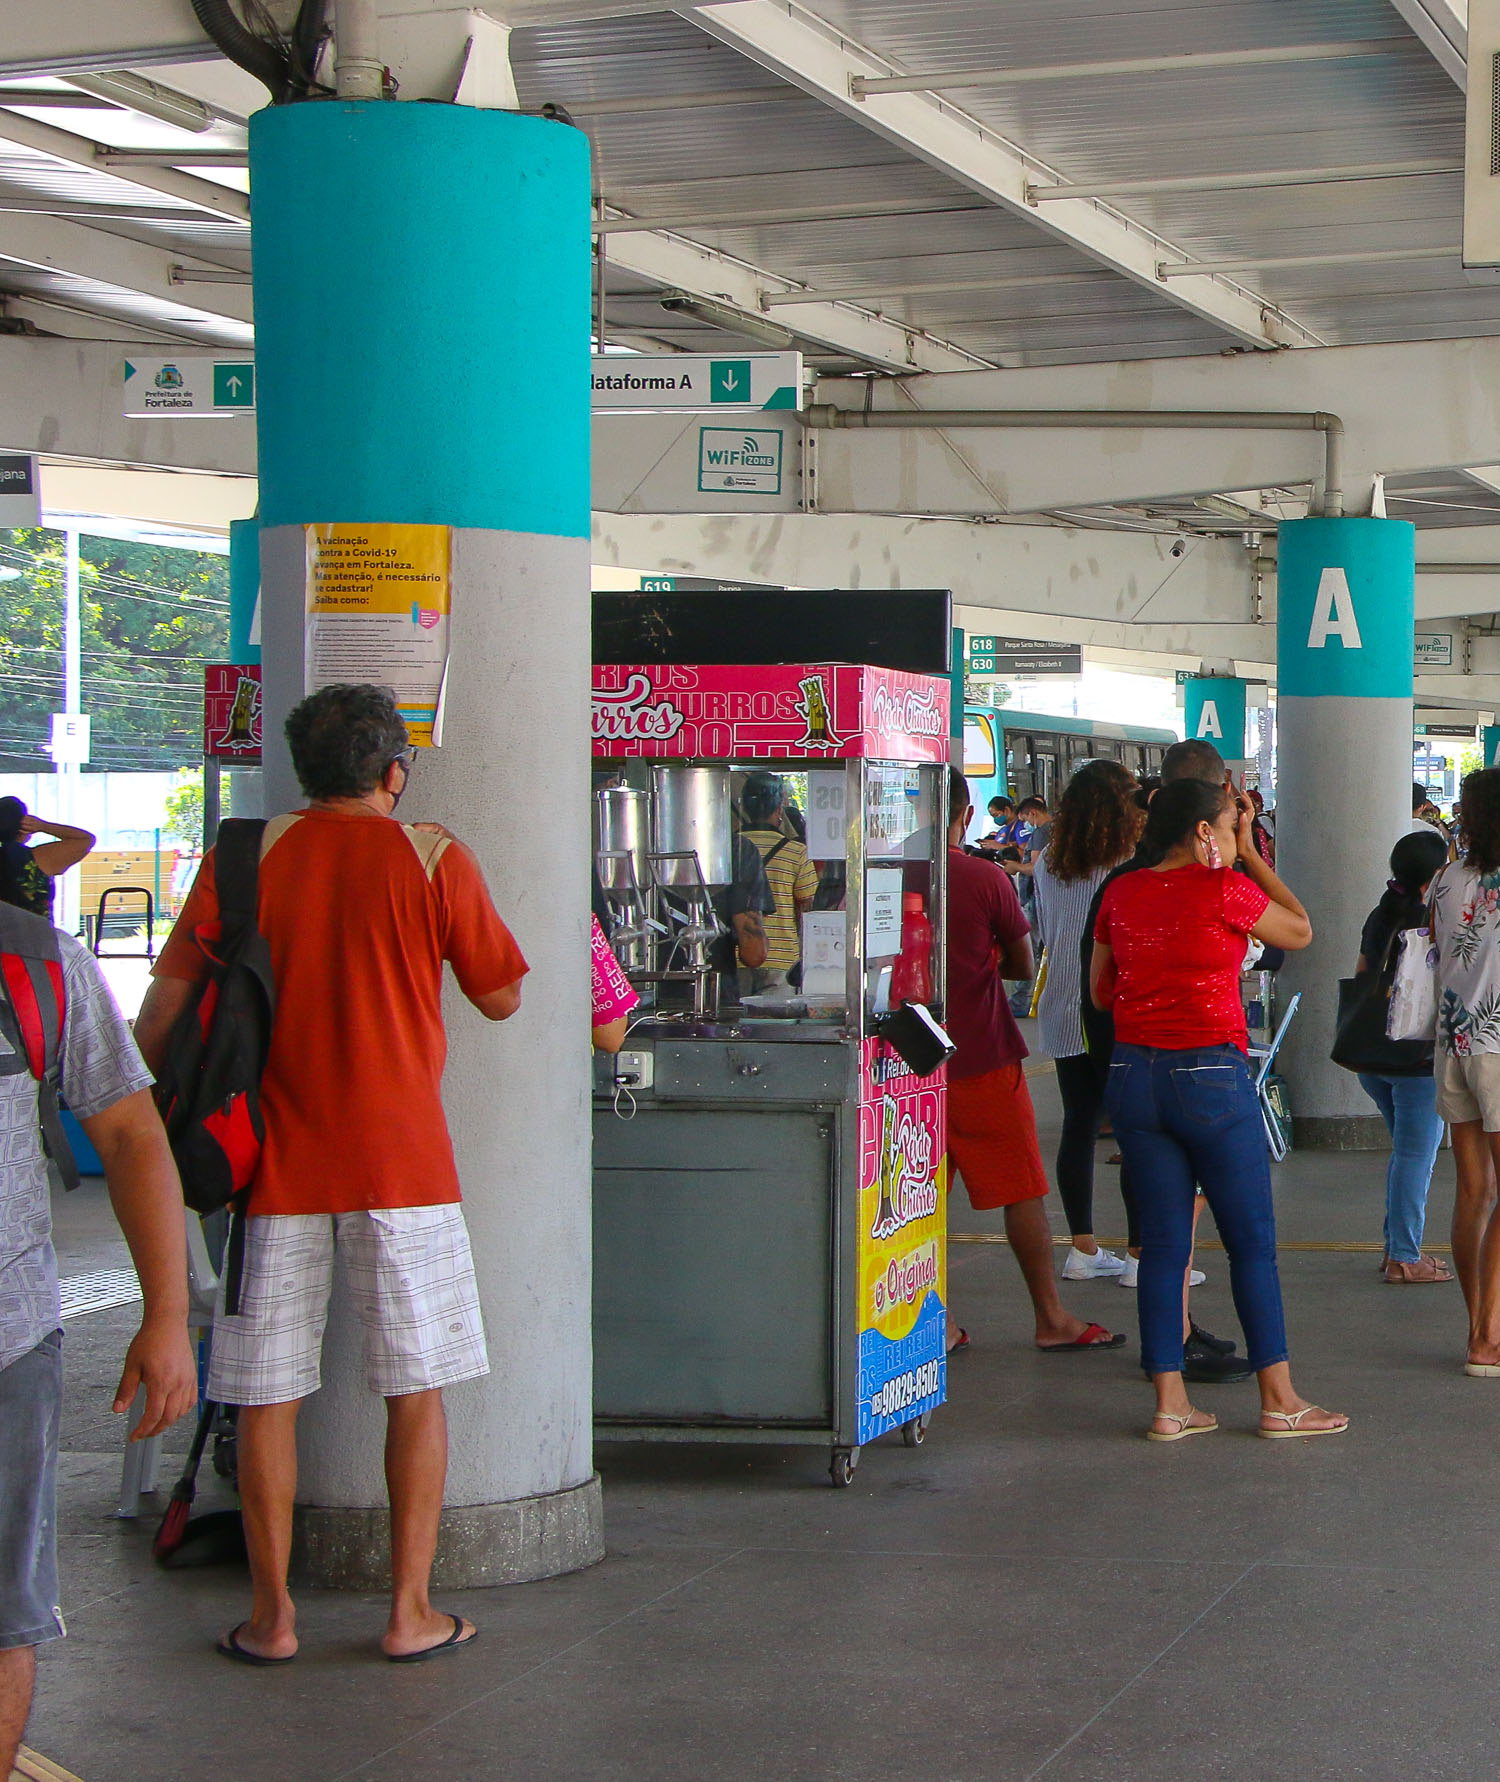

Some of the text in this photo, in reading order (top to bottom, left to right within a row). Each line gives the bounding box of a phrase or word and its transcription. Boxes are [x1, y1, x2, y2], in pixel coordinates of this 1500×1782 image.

[591, 374, 692, 390] lataforma A
[145, 398, 192, 408] Fortaleza
[707, 450, 772, 465] WiFi ZONE
[0, 468, 26, 482] jana
[316, 536, 368, 547] A vacinação
[352, 549, 397, 557] Covid-19
[364, 560, 414, 570] Fortaleza.
[334, 572, 374, 582] atenção,
[377, 572, 382, 580] é
[385, 573, 441, 582] necessário
[325, 584, 373, 592] cadastrar!
[644, 582, 670, 591] 619
[315, 596, 338, 604] Saiba
[1307, 568, 1362, 649] A
[972, 640, 993, 650] 618
[972, 659, 993, 670] 630
[1196, 700, 1223, 738] A
[67, 722, 76, 735] E
[608, 968, 629, 1000] REI
[592, 1000, 613, 1014] RRO
[887, 1242, 936, 1303] Original
[882, 1358, 938, 1418] 98829-8502
